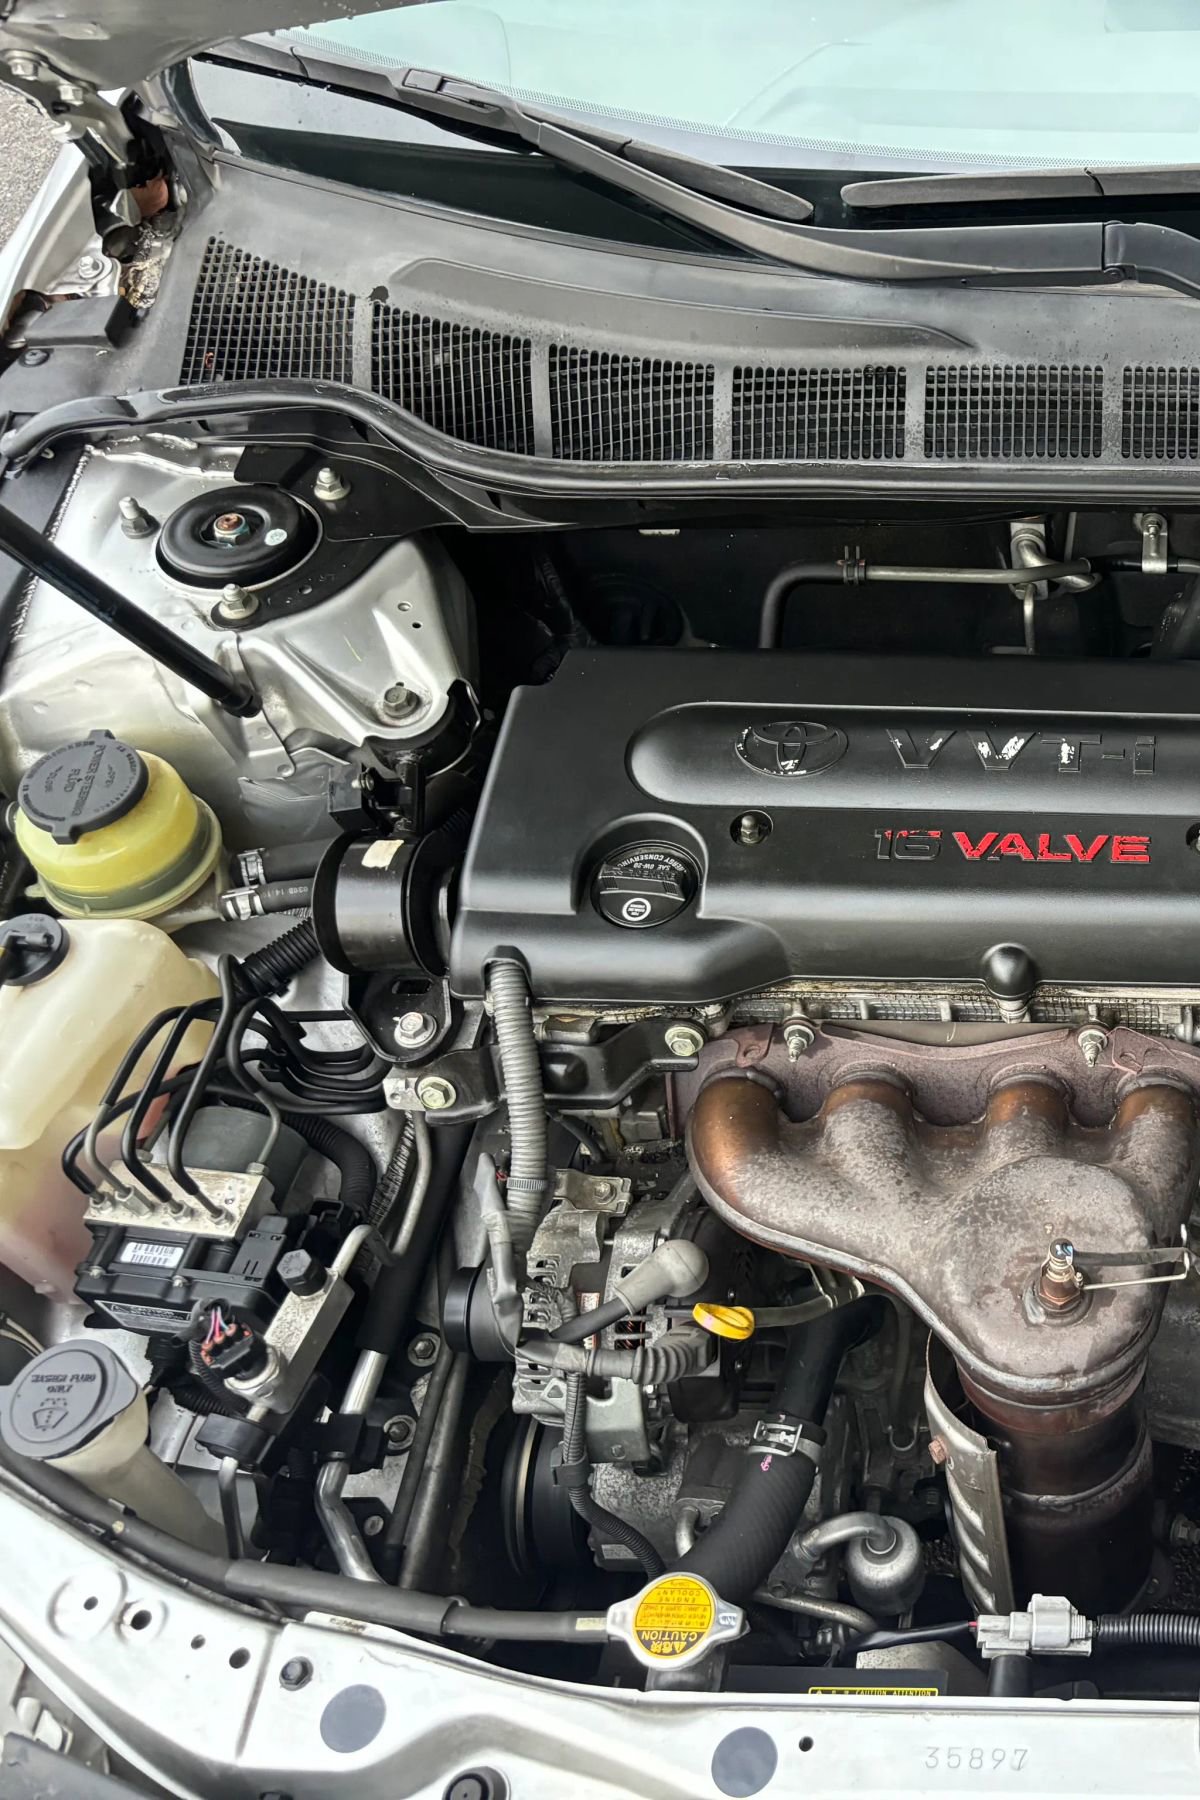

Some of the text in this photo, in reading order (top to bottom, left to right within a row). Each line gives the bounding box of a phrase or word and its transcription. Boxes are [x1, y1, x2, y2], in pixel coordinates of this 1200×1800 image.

[874, 828, 1151, 864] 16 VALVE
[656, 1589, 701, 1597] COOLANT
[658, 1596, 697, 1604] ENGINE
[641, 1631, 699, 1642] CAUTION
[924, 1746, 1029, 1771] 35897
